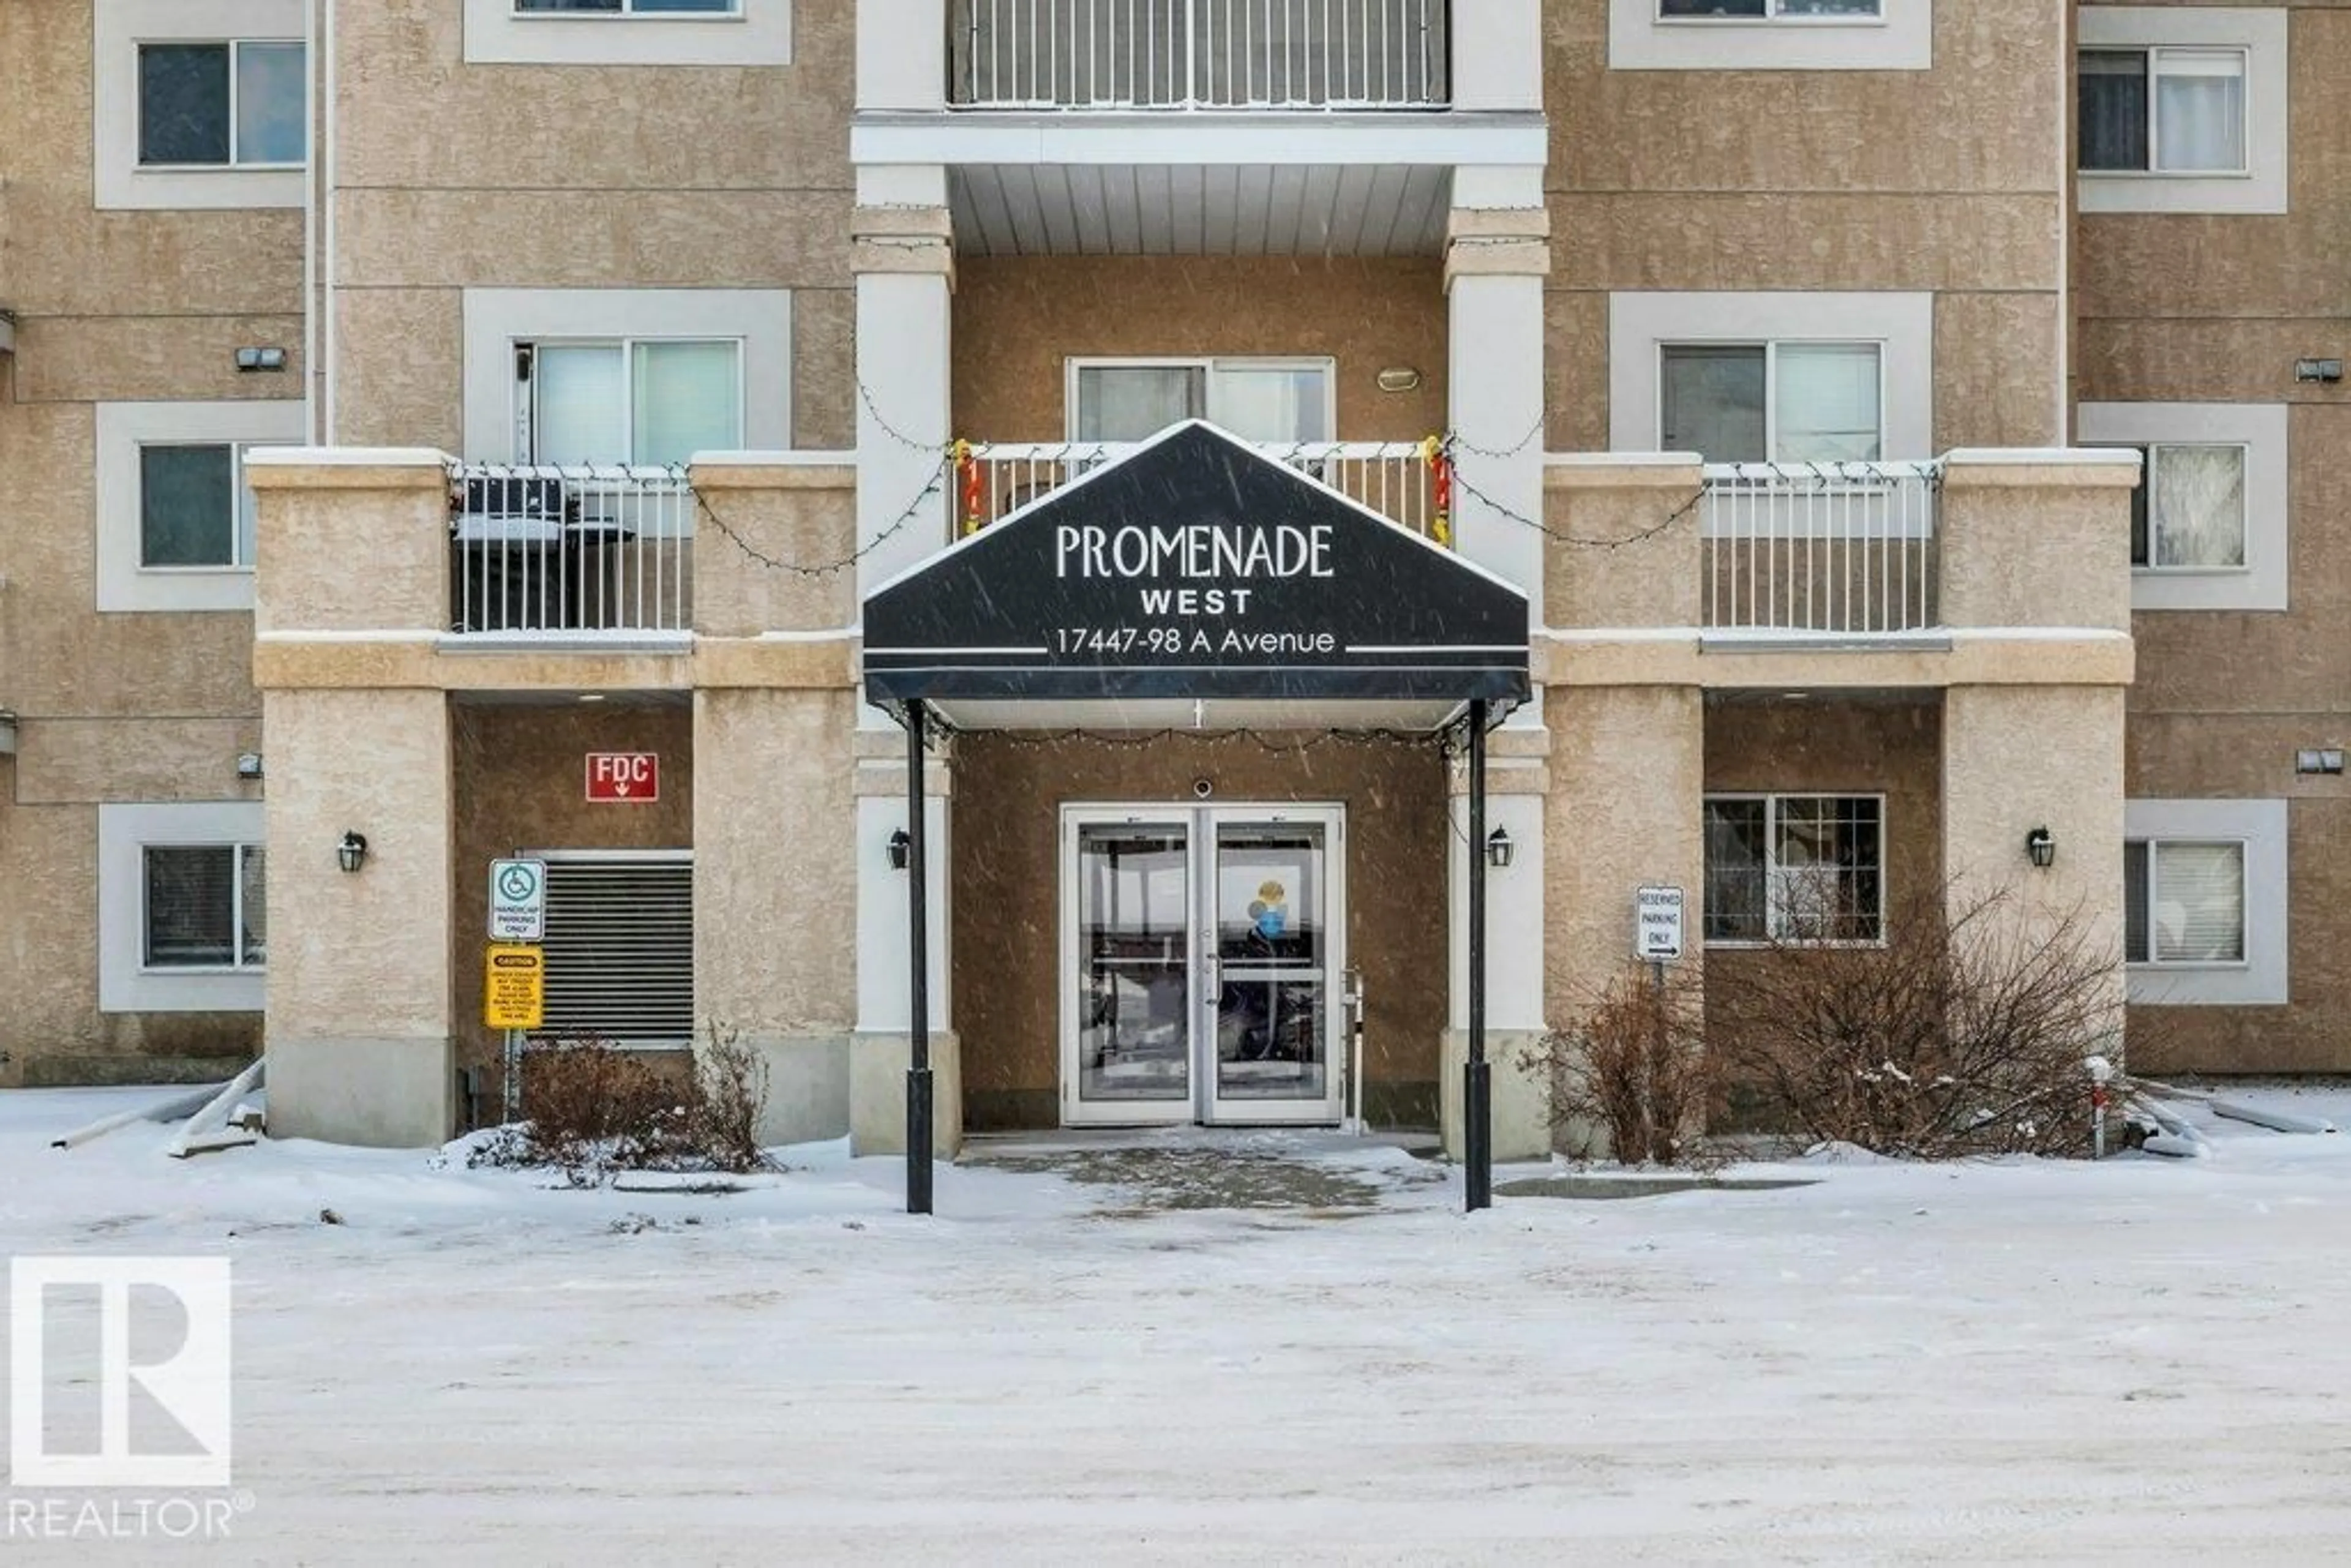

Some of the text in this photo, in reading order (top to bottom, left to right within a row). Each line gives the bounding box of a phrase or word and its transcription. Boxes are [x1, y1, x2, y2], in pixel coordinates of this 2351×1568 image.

[1056, 525, 1335, 577] PROMENADE
[1140, 589, 1253, 615] WEST
[1057, 628, 1335, 653] 17447-98 A Avenue
[596, 757, 649, 782] FDC
[1640, 893, 1680, 906] RESERVED
[1641, 912, 1678, 925] PARKING
[1648, 932, 1670, 944] ONLY
